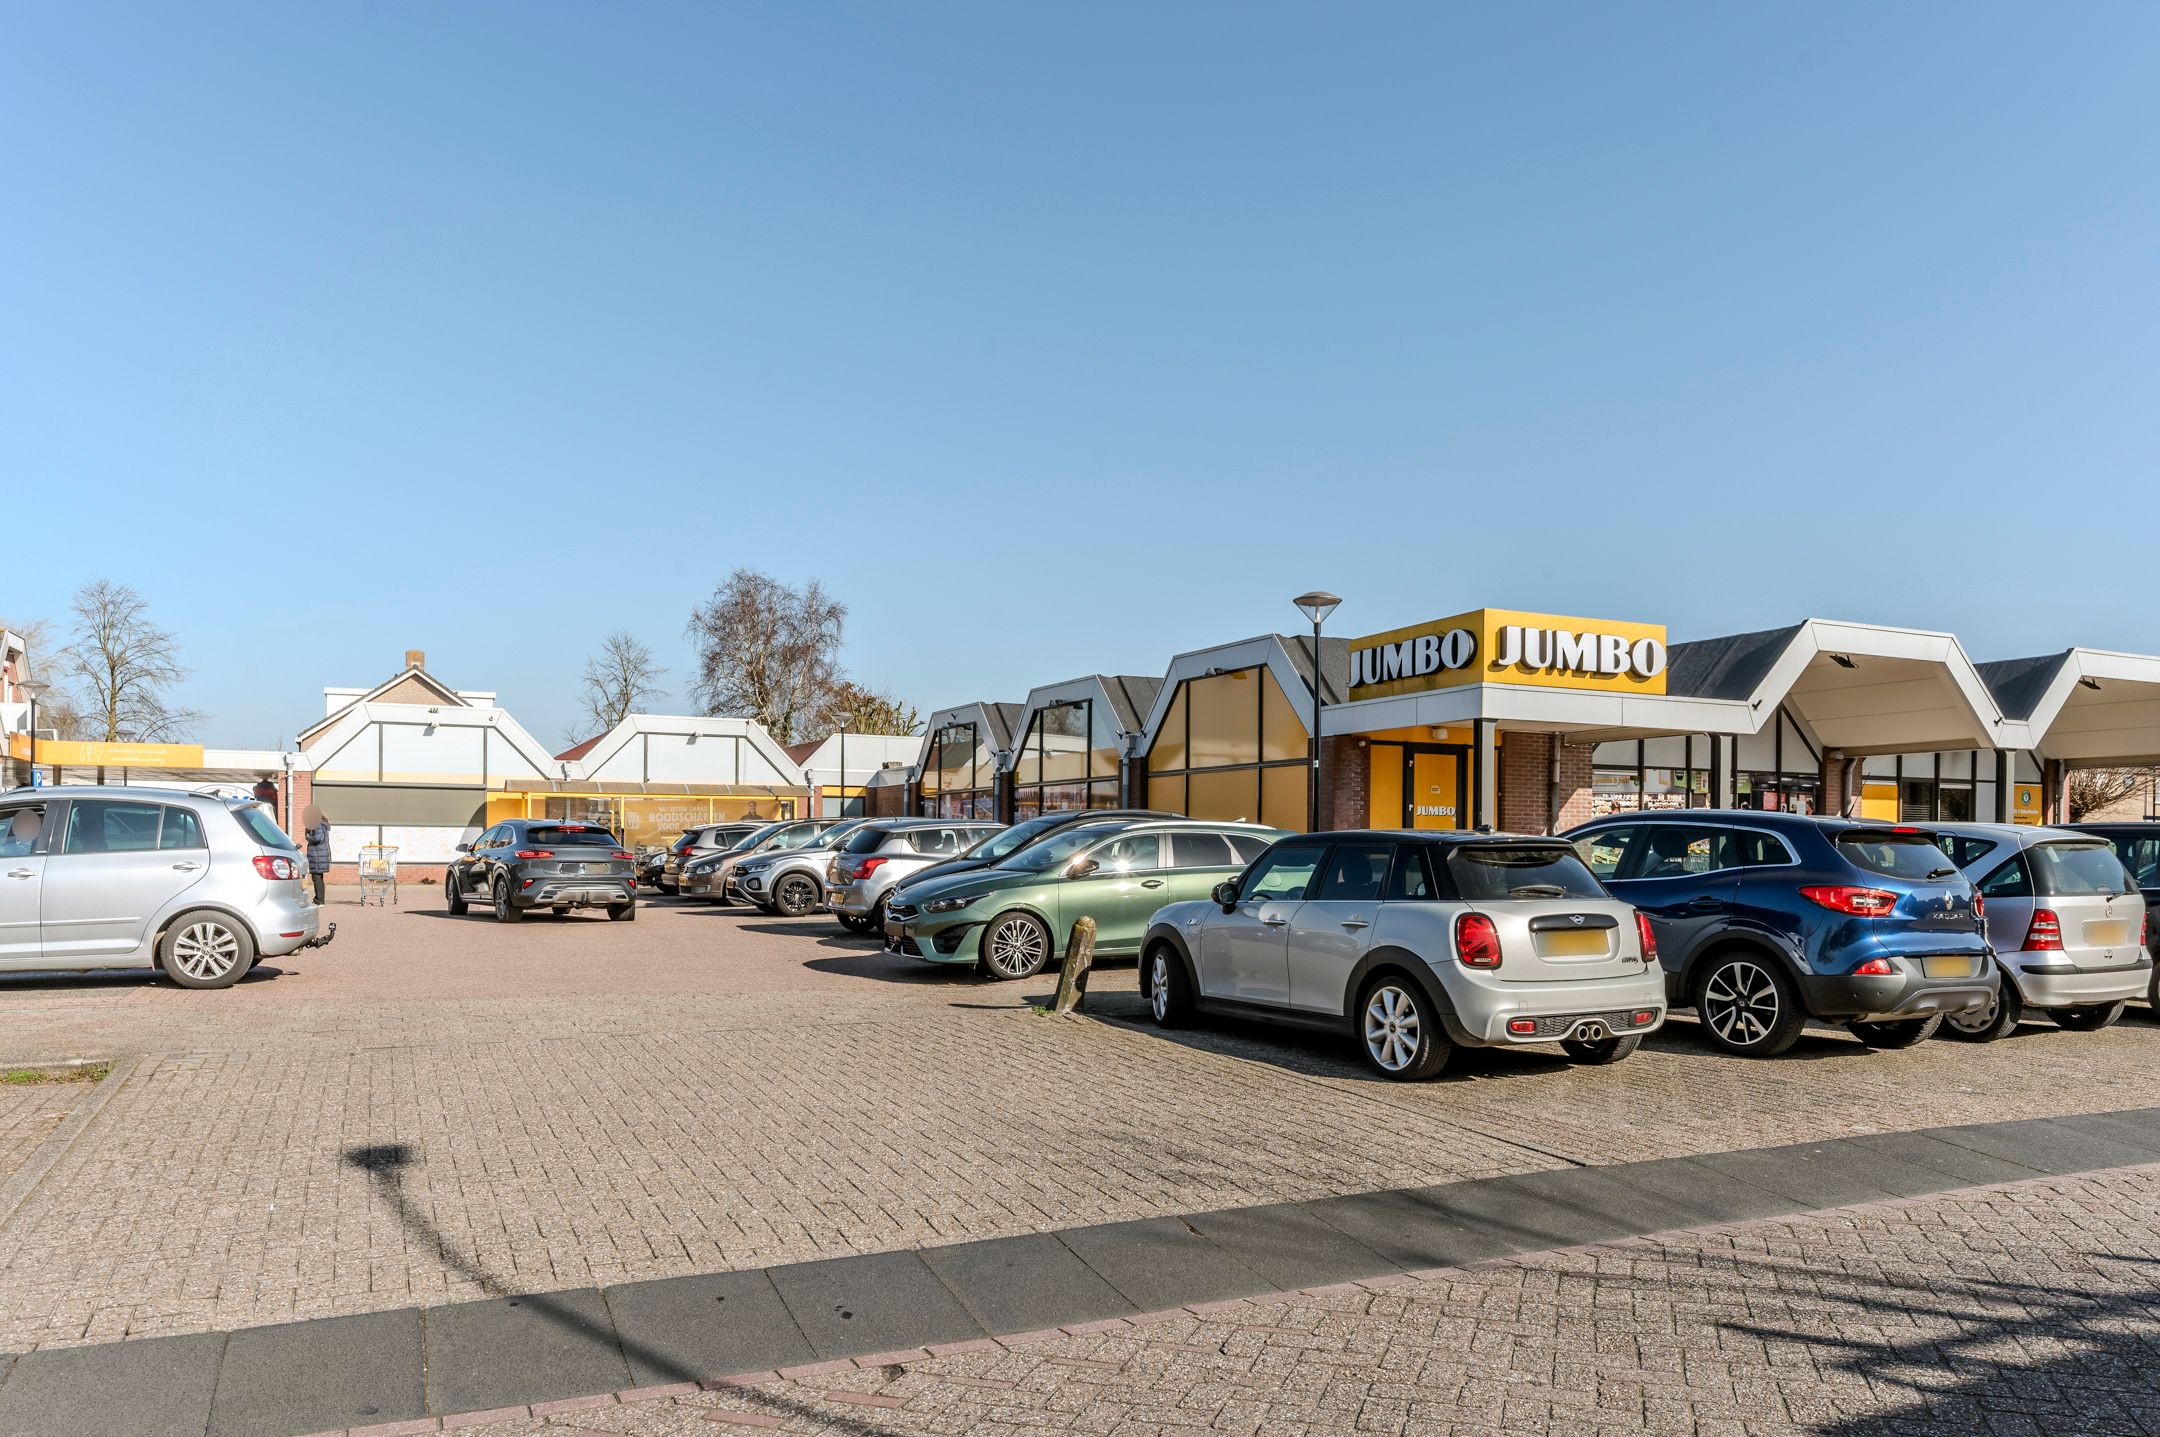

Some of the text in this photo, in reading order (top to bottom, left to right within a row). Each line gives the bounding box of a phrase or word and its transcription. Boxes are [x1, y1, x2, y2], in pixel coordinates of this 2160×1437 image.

[1349, 628, 1473, 688] JUMBO
[1498, 625, 1667, 678] JUMBO
[36, 772, 42, 787] P
[648, 812, 725, 822] BOODSCHAPEN
[1416, 805, 1456, 816] JUMBO
[657, 822, 680, 831] VOOR
